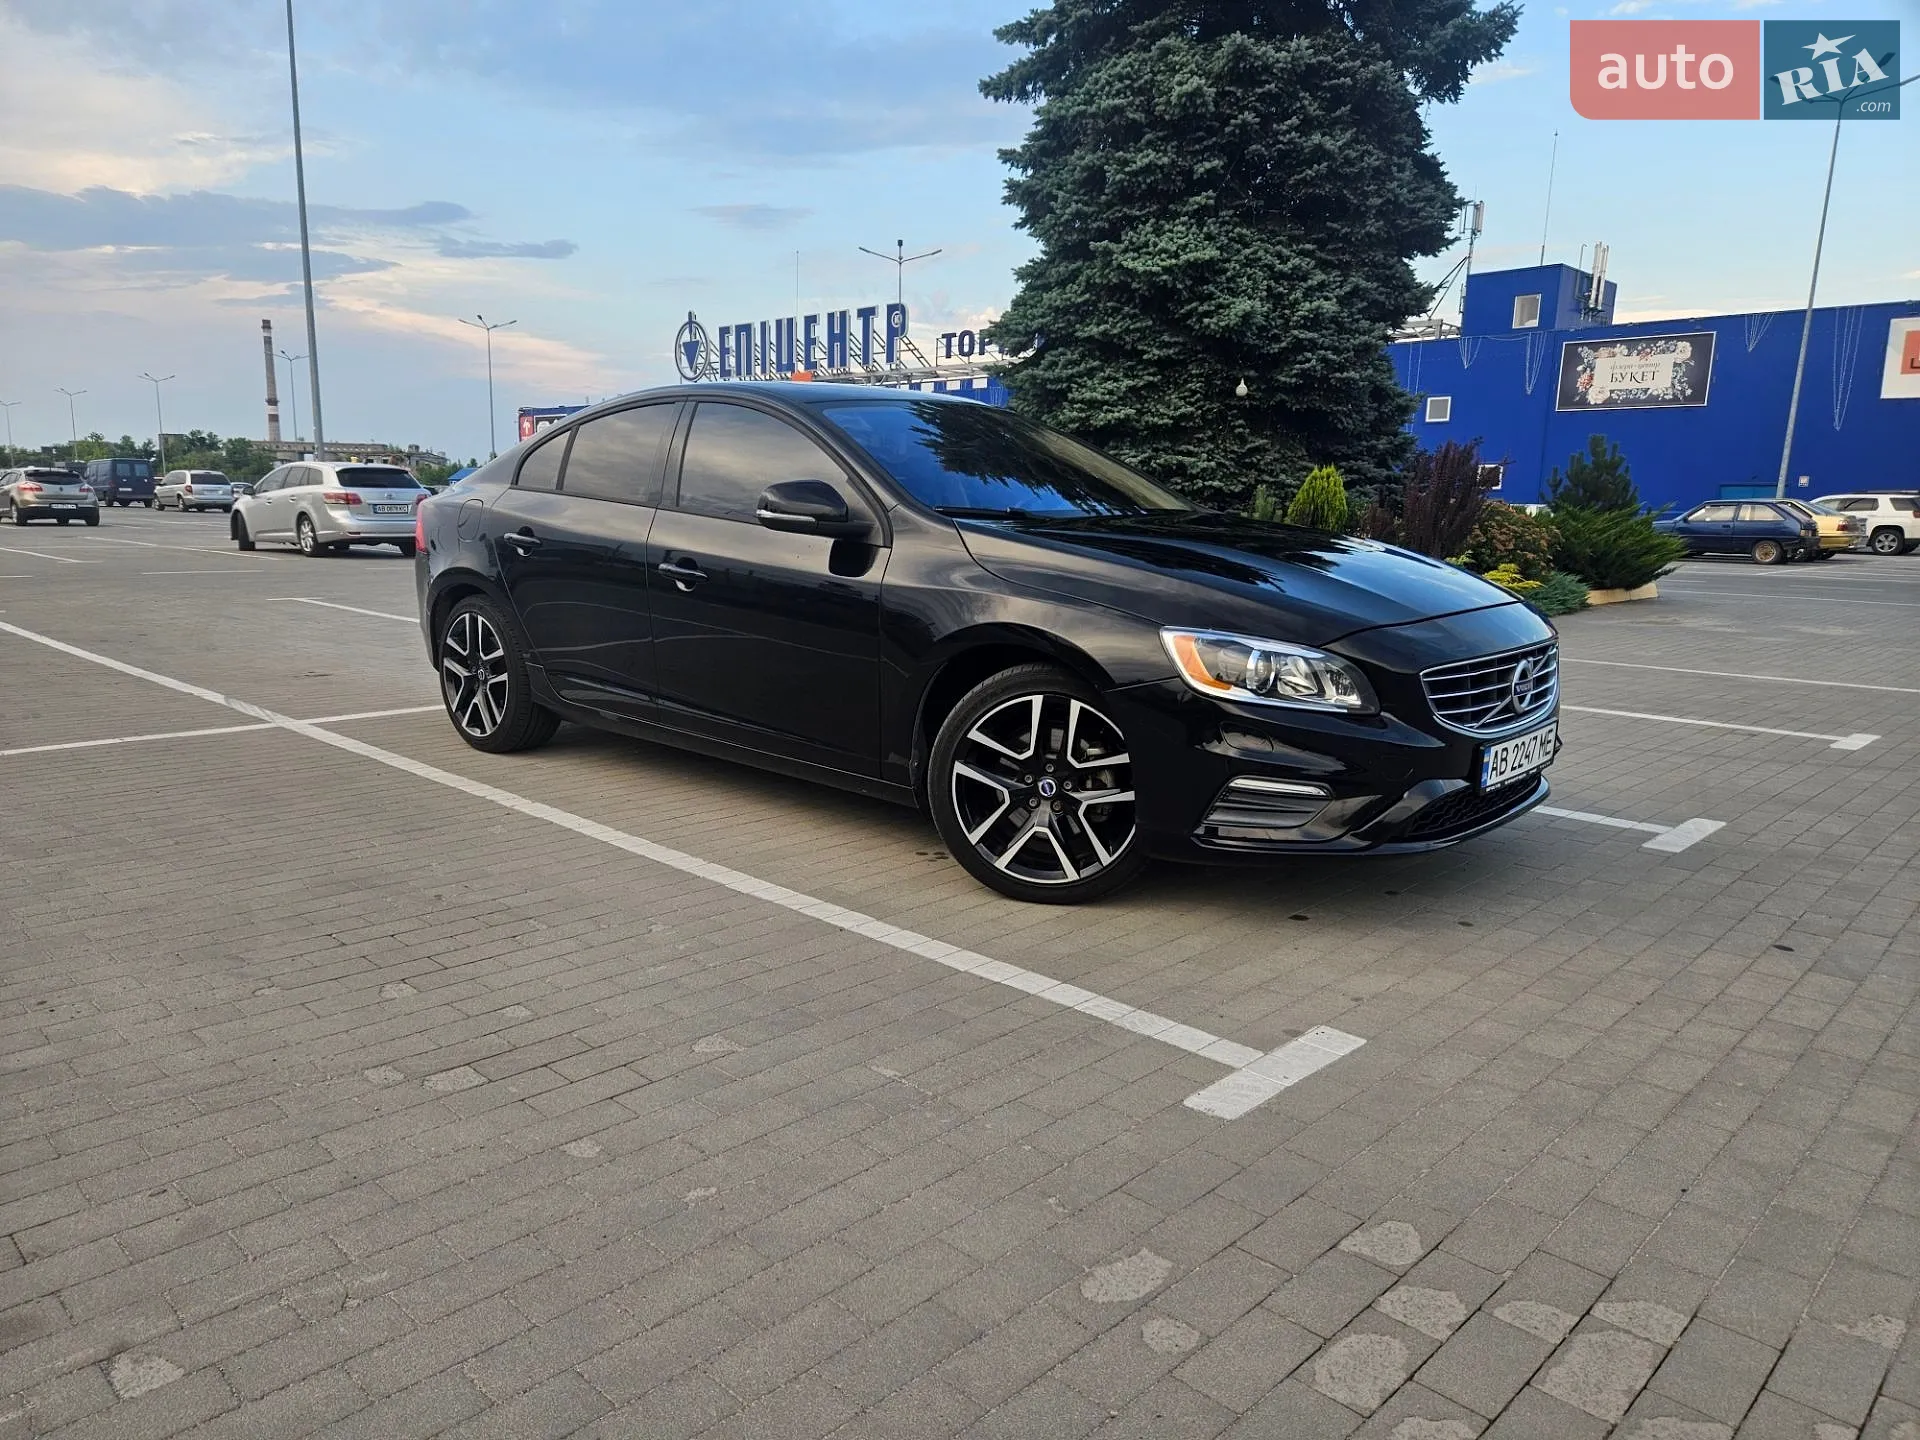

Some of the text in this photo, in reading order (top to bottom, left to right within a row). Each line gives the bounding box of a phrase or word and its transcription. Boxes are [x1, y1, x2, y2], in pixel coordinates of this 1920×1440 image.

[718, 302, 909, 378] ЕПІЦЕНТР
[1610, 370, 1660, 383] БУКЕТ
[1490, 747, 1509, 780] AB
[1510, 735, 1537, 771] 2247
[1538, 728, 1553, 760] ME
